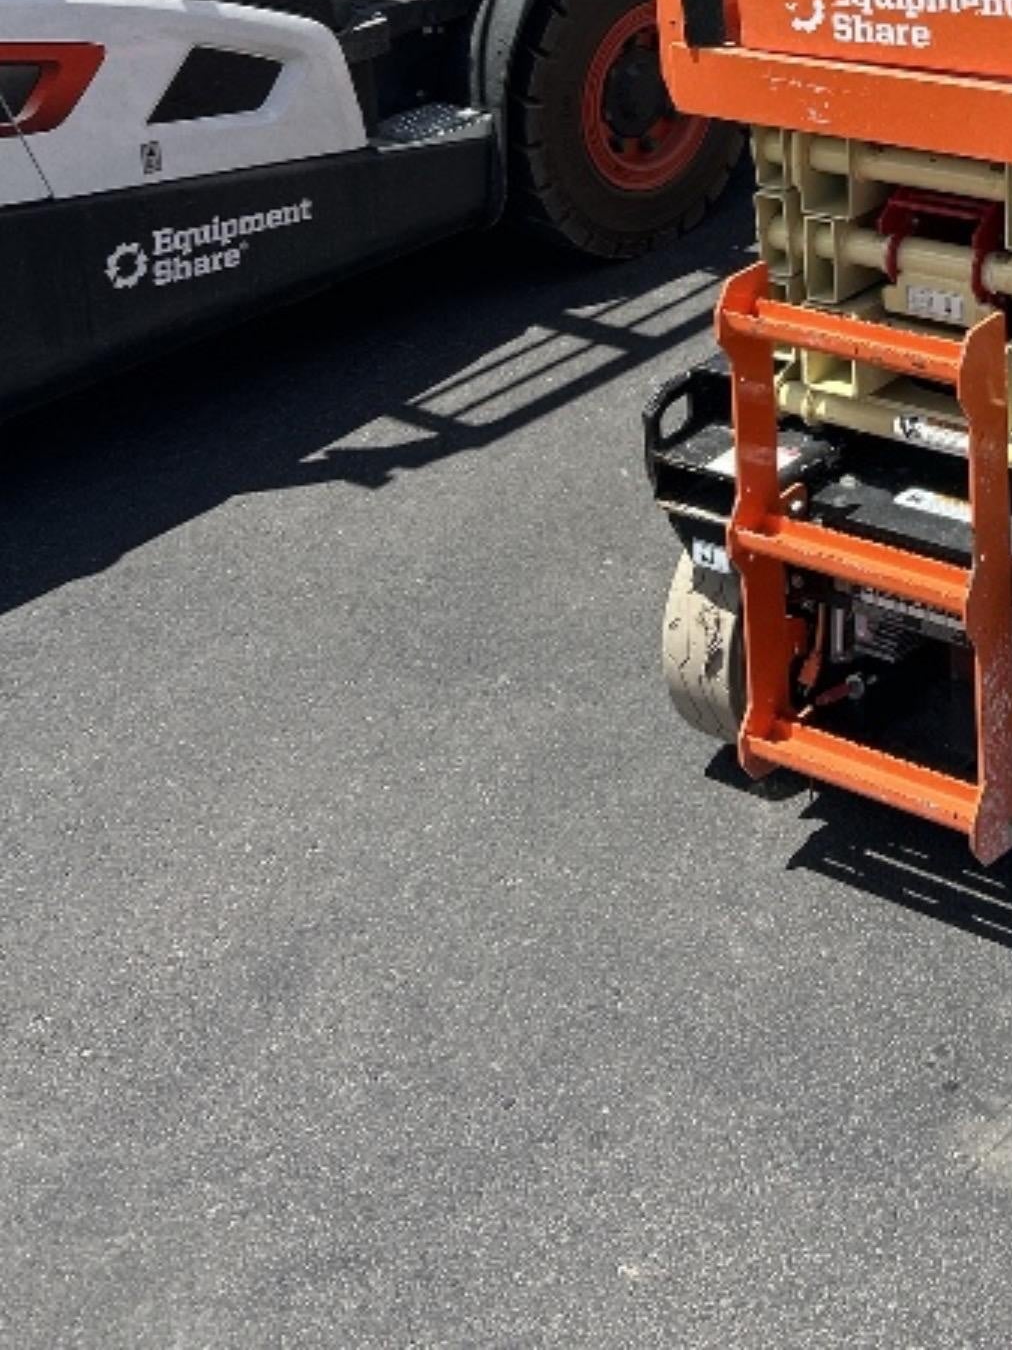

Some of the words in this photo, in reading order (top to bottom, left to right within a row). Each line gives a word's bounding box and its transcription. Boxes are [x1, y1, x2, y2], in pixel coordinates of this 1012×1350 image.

[831, 12, 932, 48] Share
[152, 197, 313, 256] Equipment
[153, 248, 241, 286] Share
